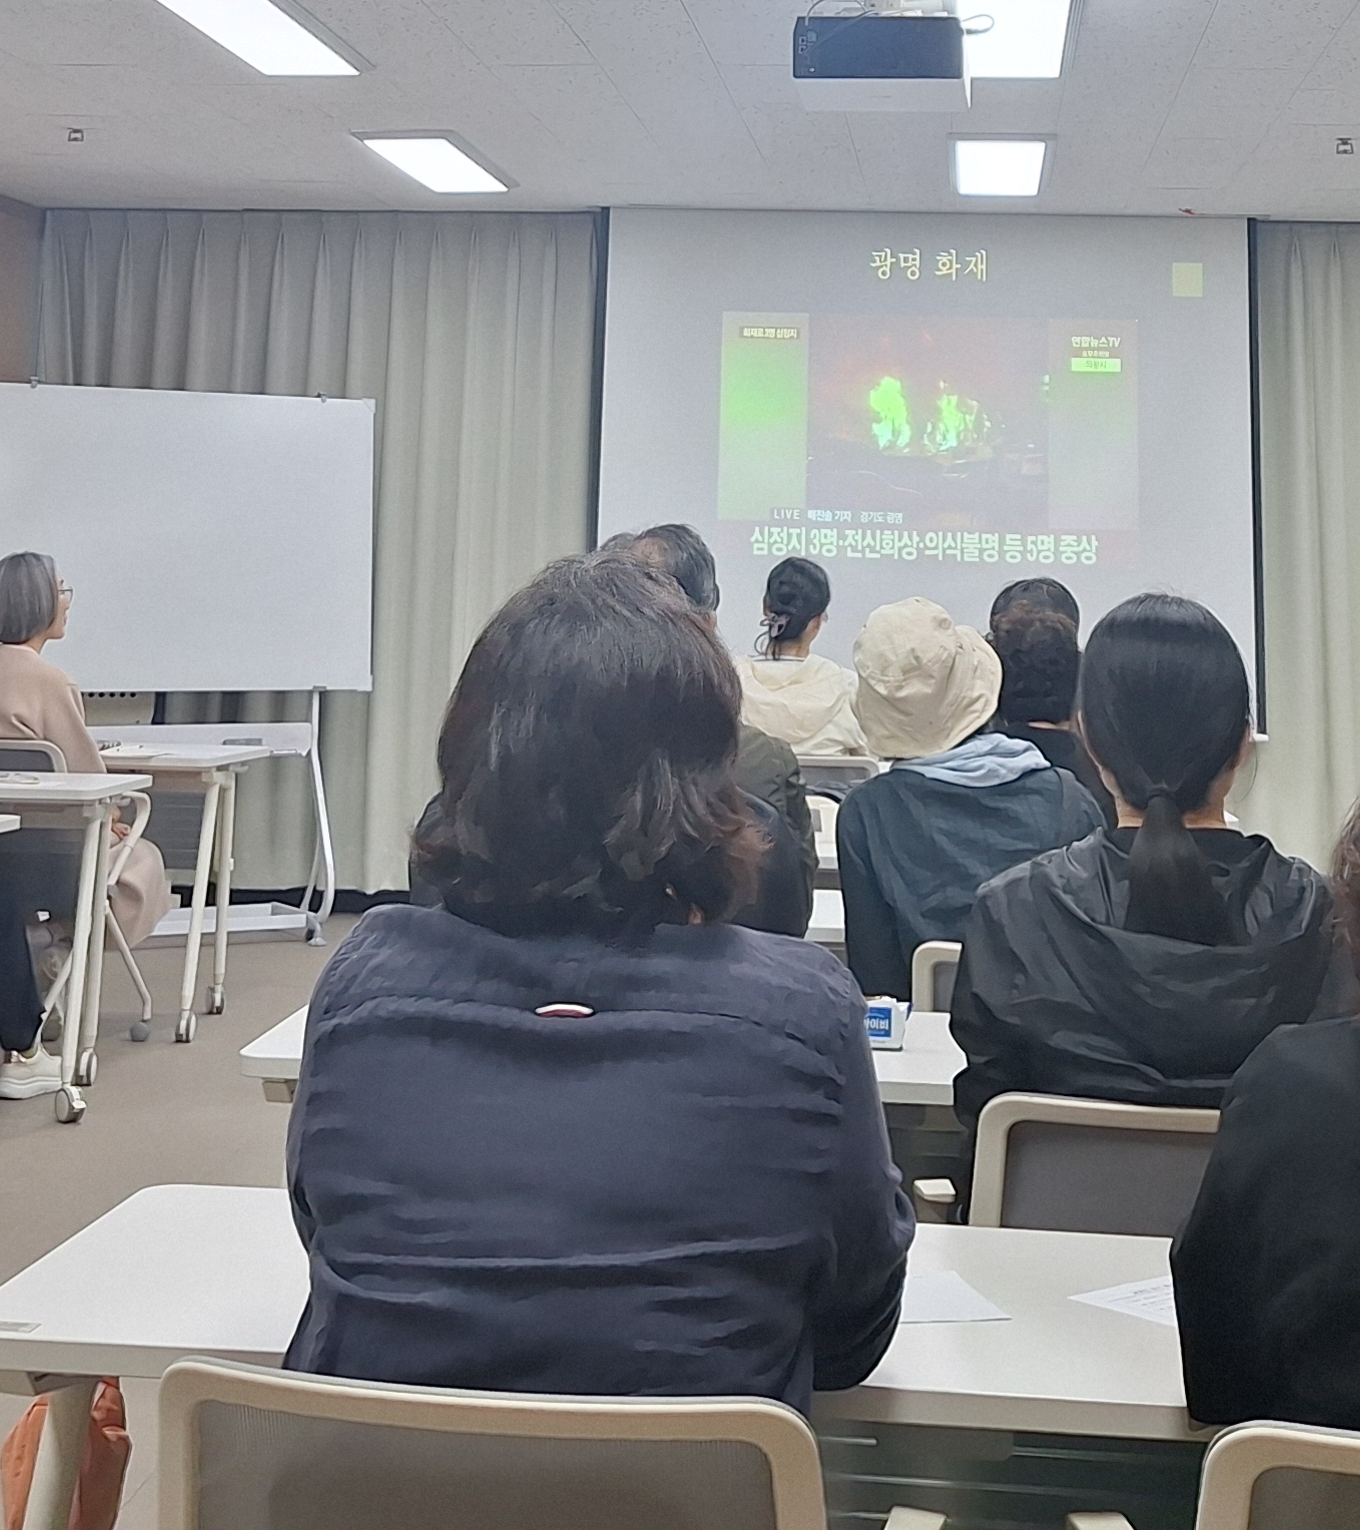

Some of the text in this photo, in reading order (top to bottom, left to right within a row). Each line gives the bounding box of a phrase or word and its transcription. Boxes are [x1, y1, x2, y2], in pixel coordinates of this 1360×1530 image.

[869, 248, 988, 282] 광명 화재
[1071, 336, 1121, 348] 연합뉴스TV
[774, 508, 800, 520] LIVE
[834, 510, 852, 522] 기자
[860, 511, 885, 523] 경기도
[750, 526, 806, 556] 심정지
[1003, 533, 1024, 564] 등
[1026, 534, 1055, 564] 5명
[1059, 534, 1099, 565] 중상
